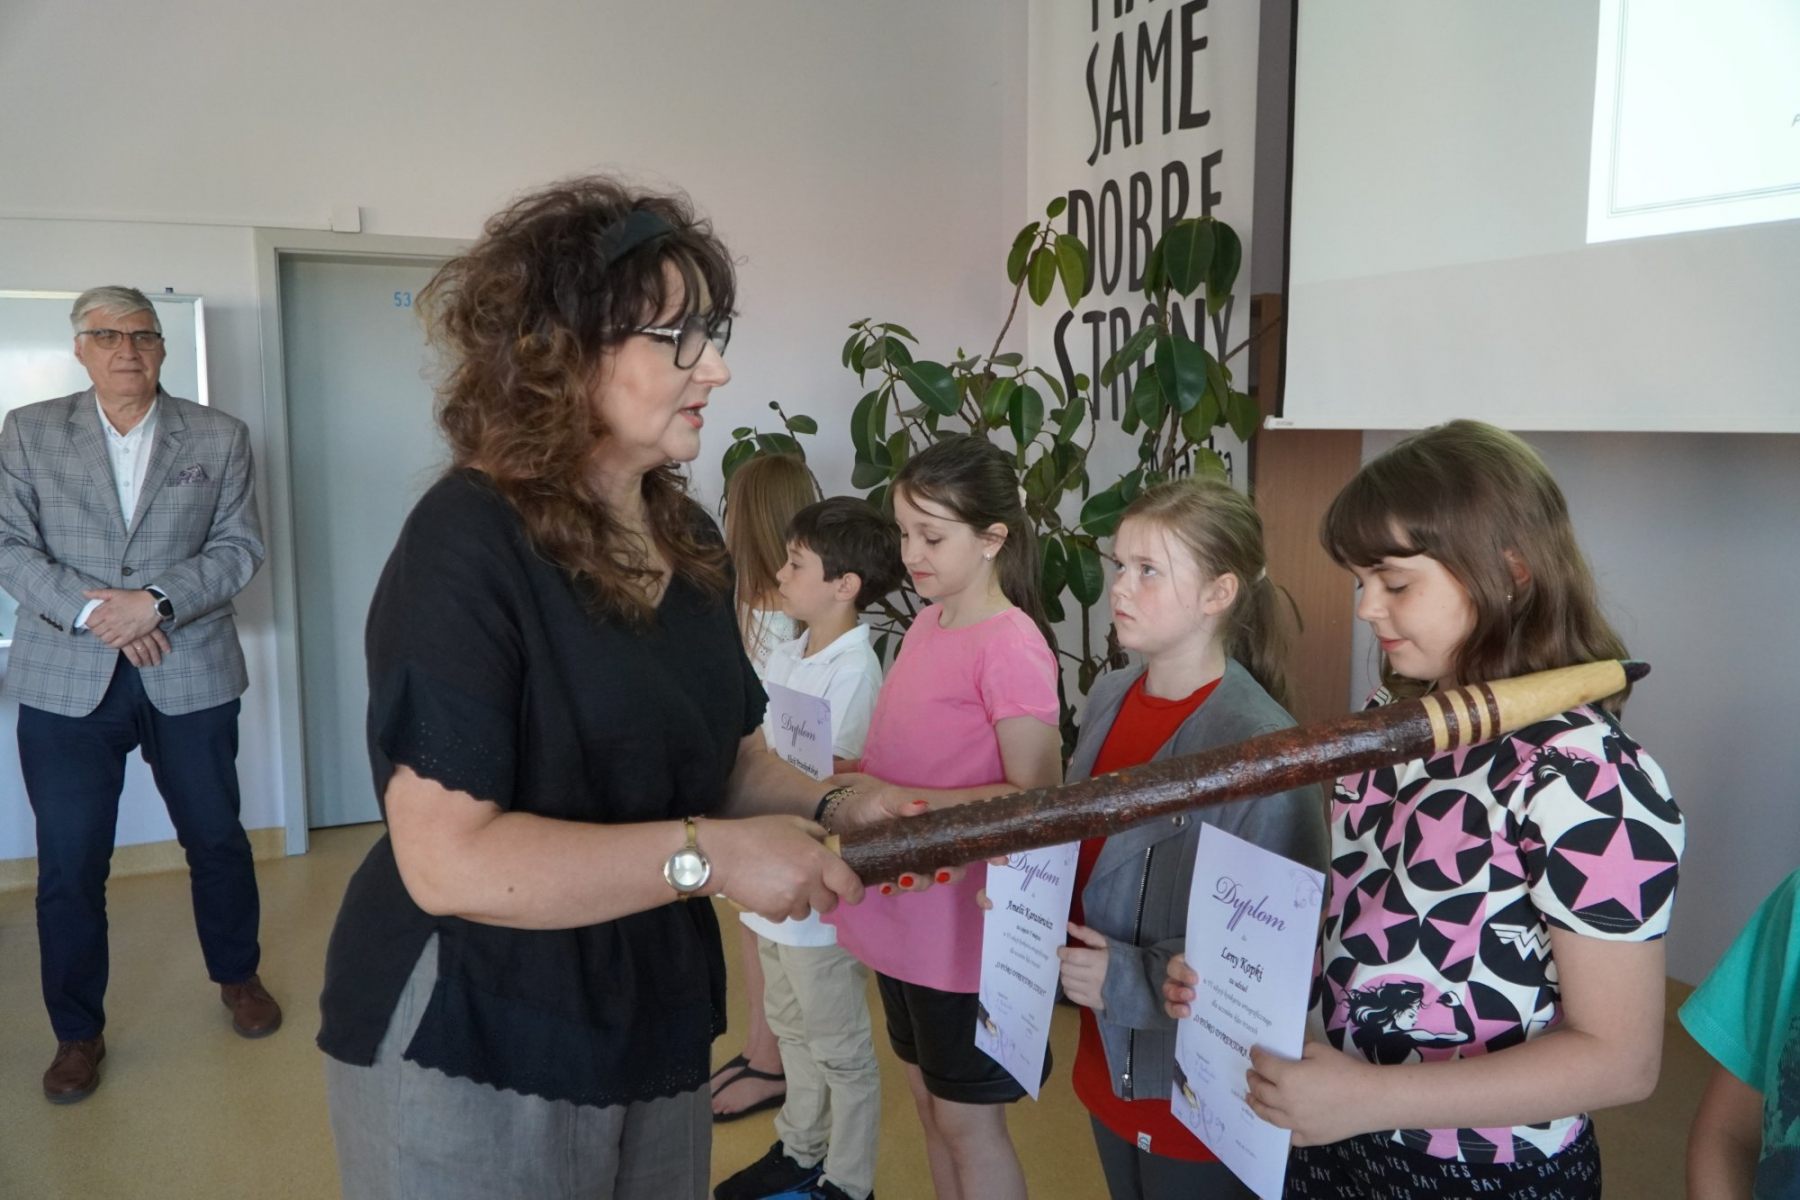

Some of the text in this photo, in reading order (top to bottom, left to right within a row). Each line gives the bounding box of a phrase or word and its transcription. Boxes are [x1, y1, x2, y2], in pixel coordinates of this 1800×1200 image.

[1086, 0, 1211, 166] SAME
[394, 291, 411, 307] 53
[781, 713, 816, 747] Dyplom
[1007, 852, 1060, 891] Dyplom
[1212, 876, 1286, 932] Dyplom
[1440, 1164, 1471, 1178] YES
[1537, 1160, 1560, 1177] SAY
[1411, 1174, 1438, 1191] SAY
[1470, 1177, 1502, 1192] SAY
